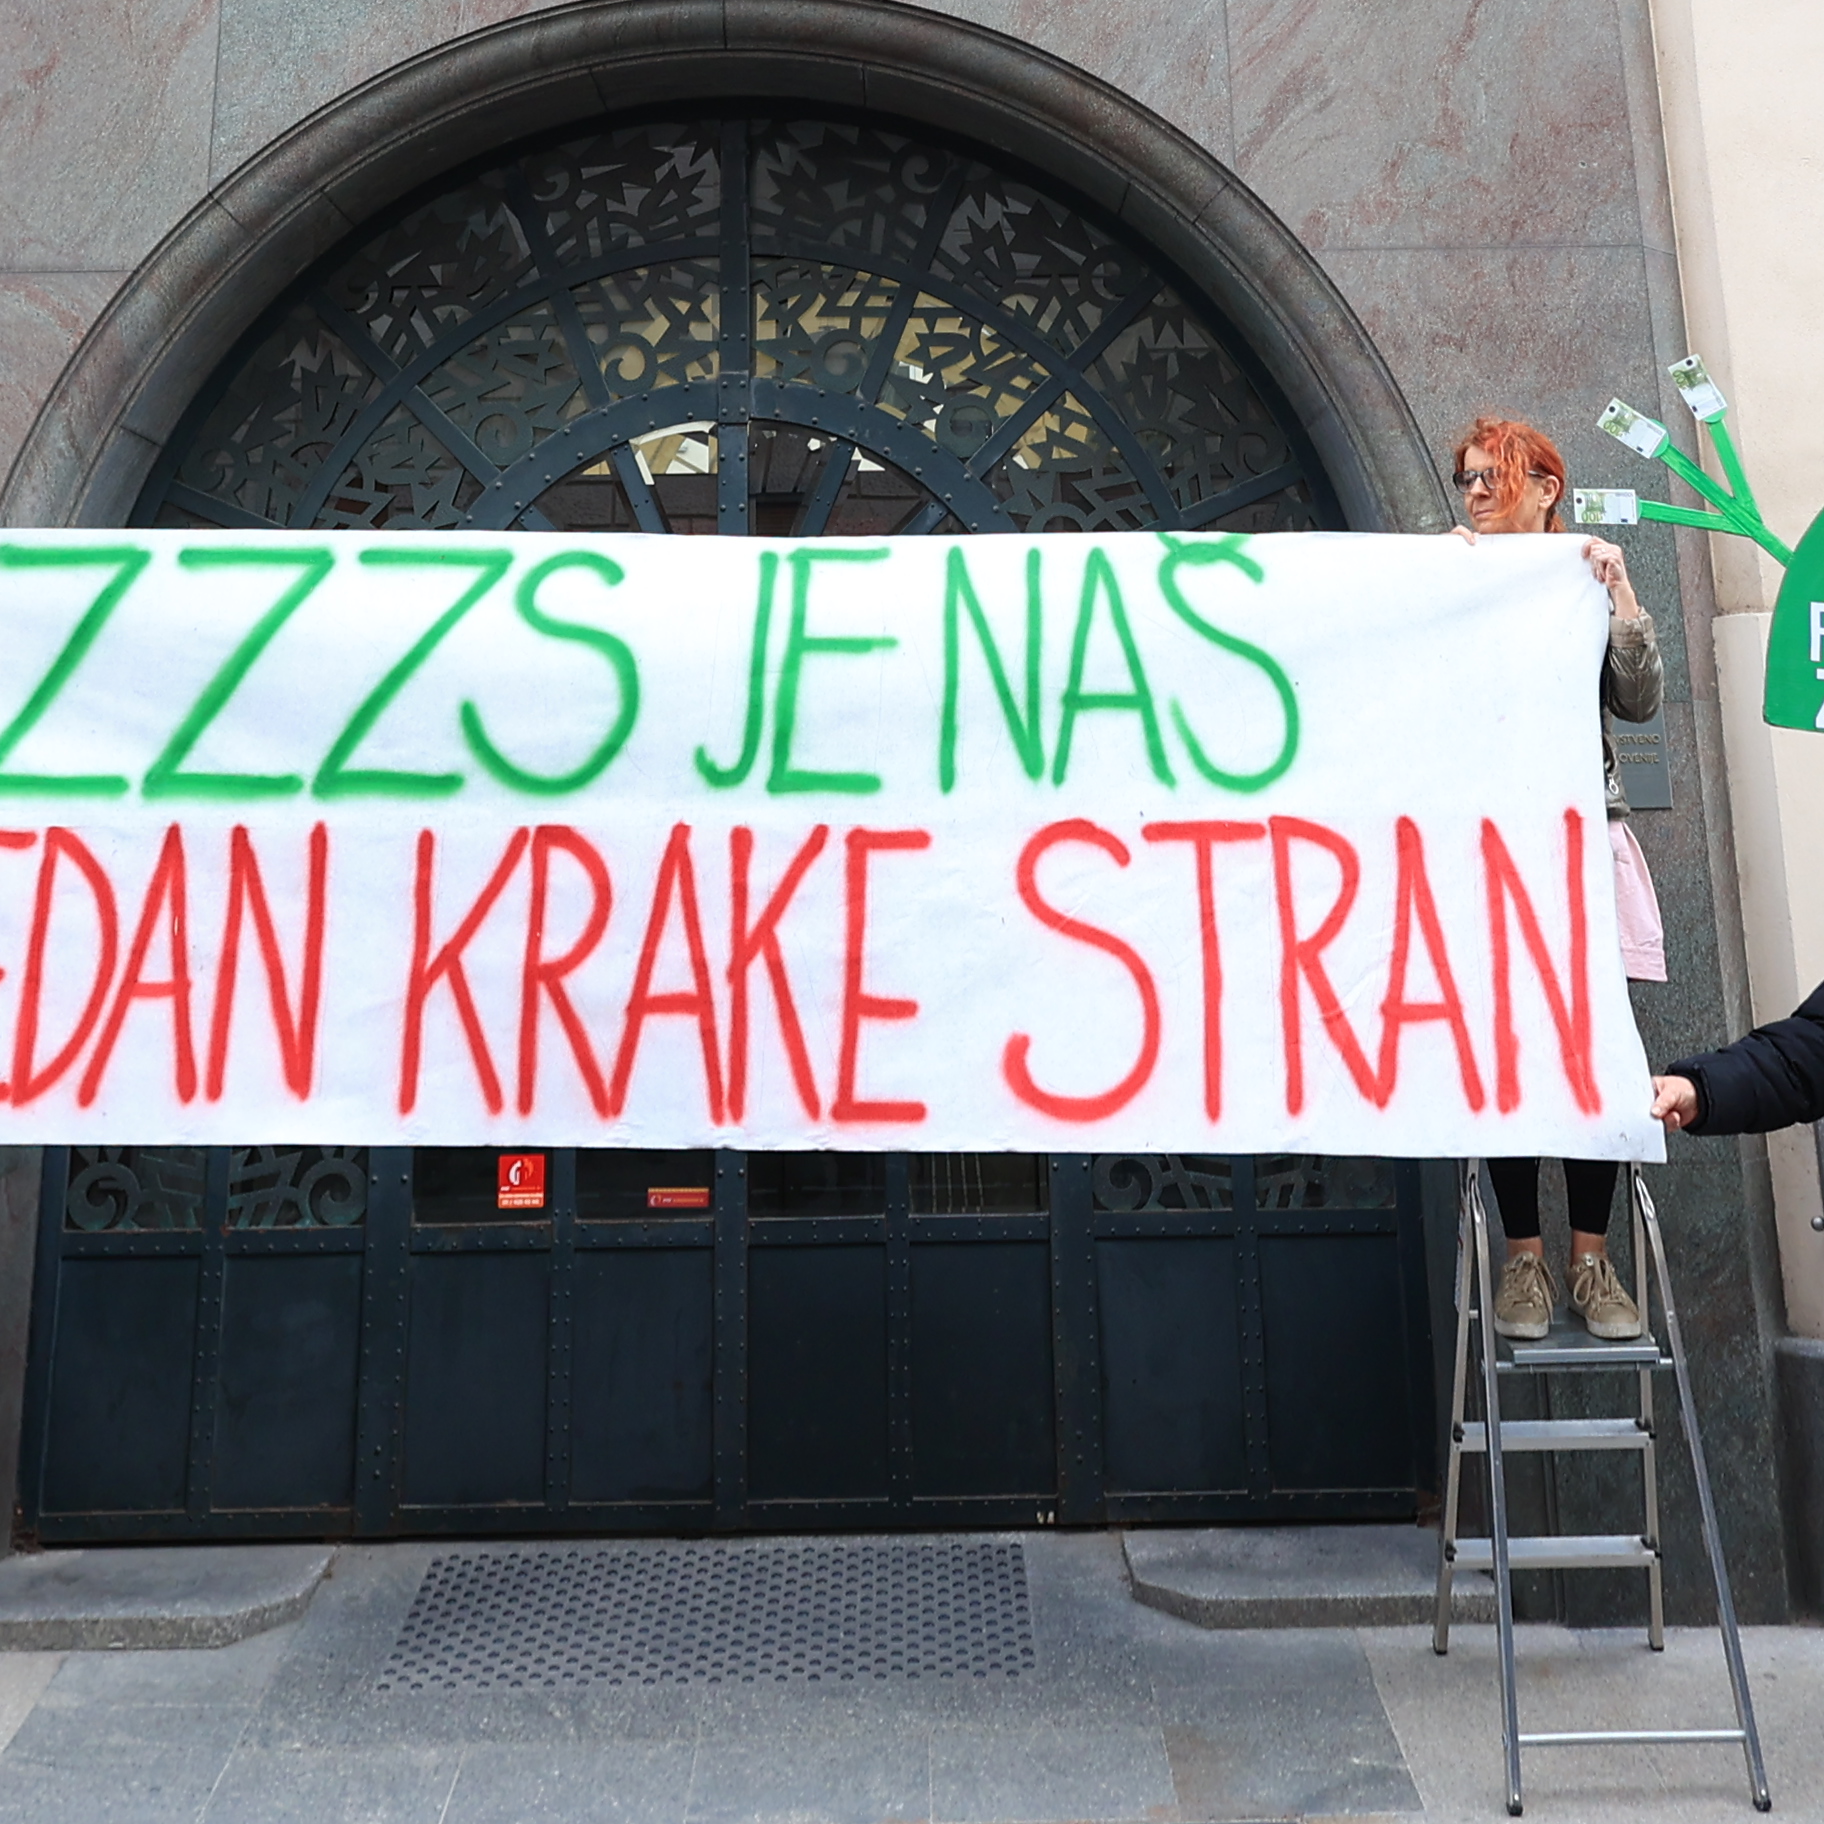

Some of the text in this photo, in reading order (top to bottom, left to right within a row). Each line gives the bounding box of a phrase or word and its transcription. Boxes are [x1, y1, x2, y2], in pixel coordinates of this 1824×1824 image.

[692, 547, 900, 798] JE
[937, 532, 1301, 797] NAŠ
[395, 821, 933, 1128] KRAKE
[999, 806, 1604, 1127] STRAN
